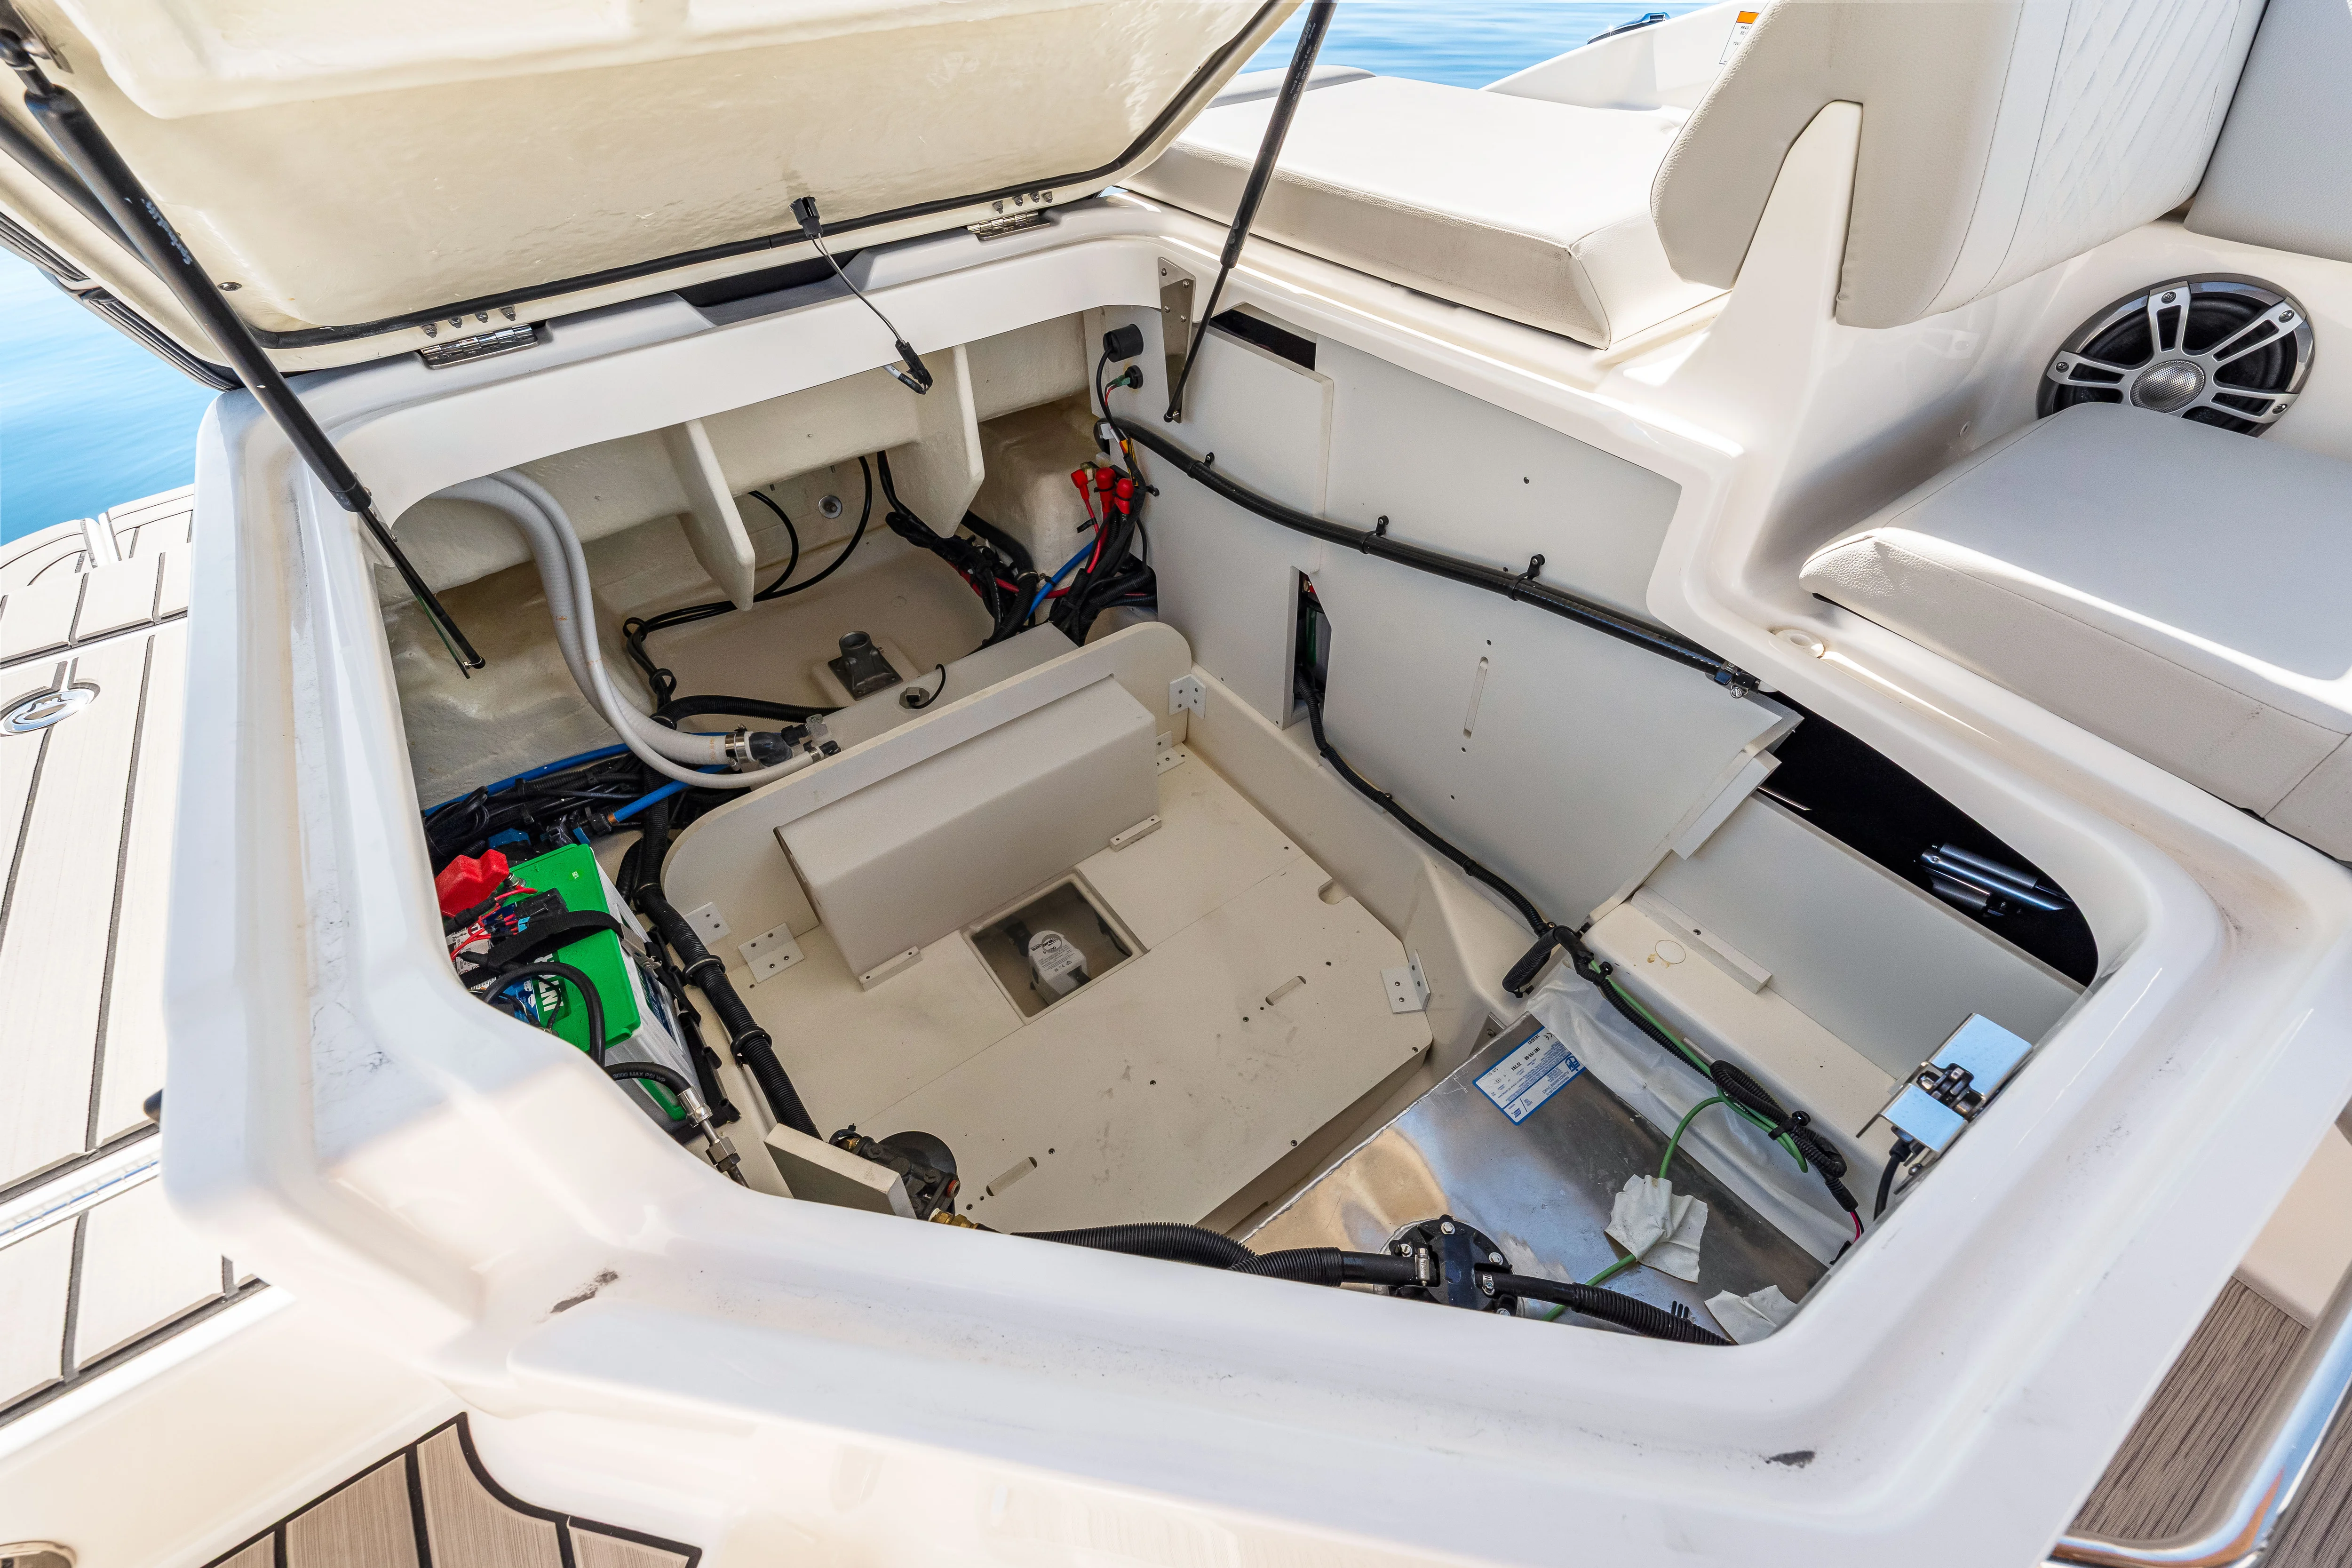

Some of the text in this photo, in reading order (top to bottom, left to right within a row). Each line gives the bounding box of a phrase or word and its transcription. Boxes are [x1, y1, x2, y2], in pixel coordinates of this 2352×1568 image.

[1301, 66, 1309, 80] OPEN
[1557, 1070, 1569, 1080] FLORIDA
[1549, 1078, 1559, 1088] MARINE
